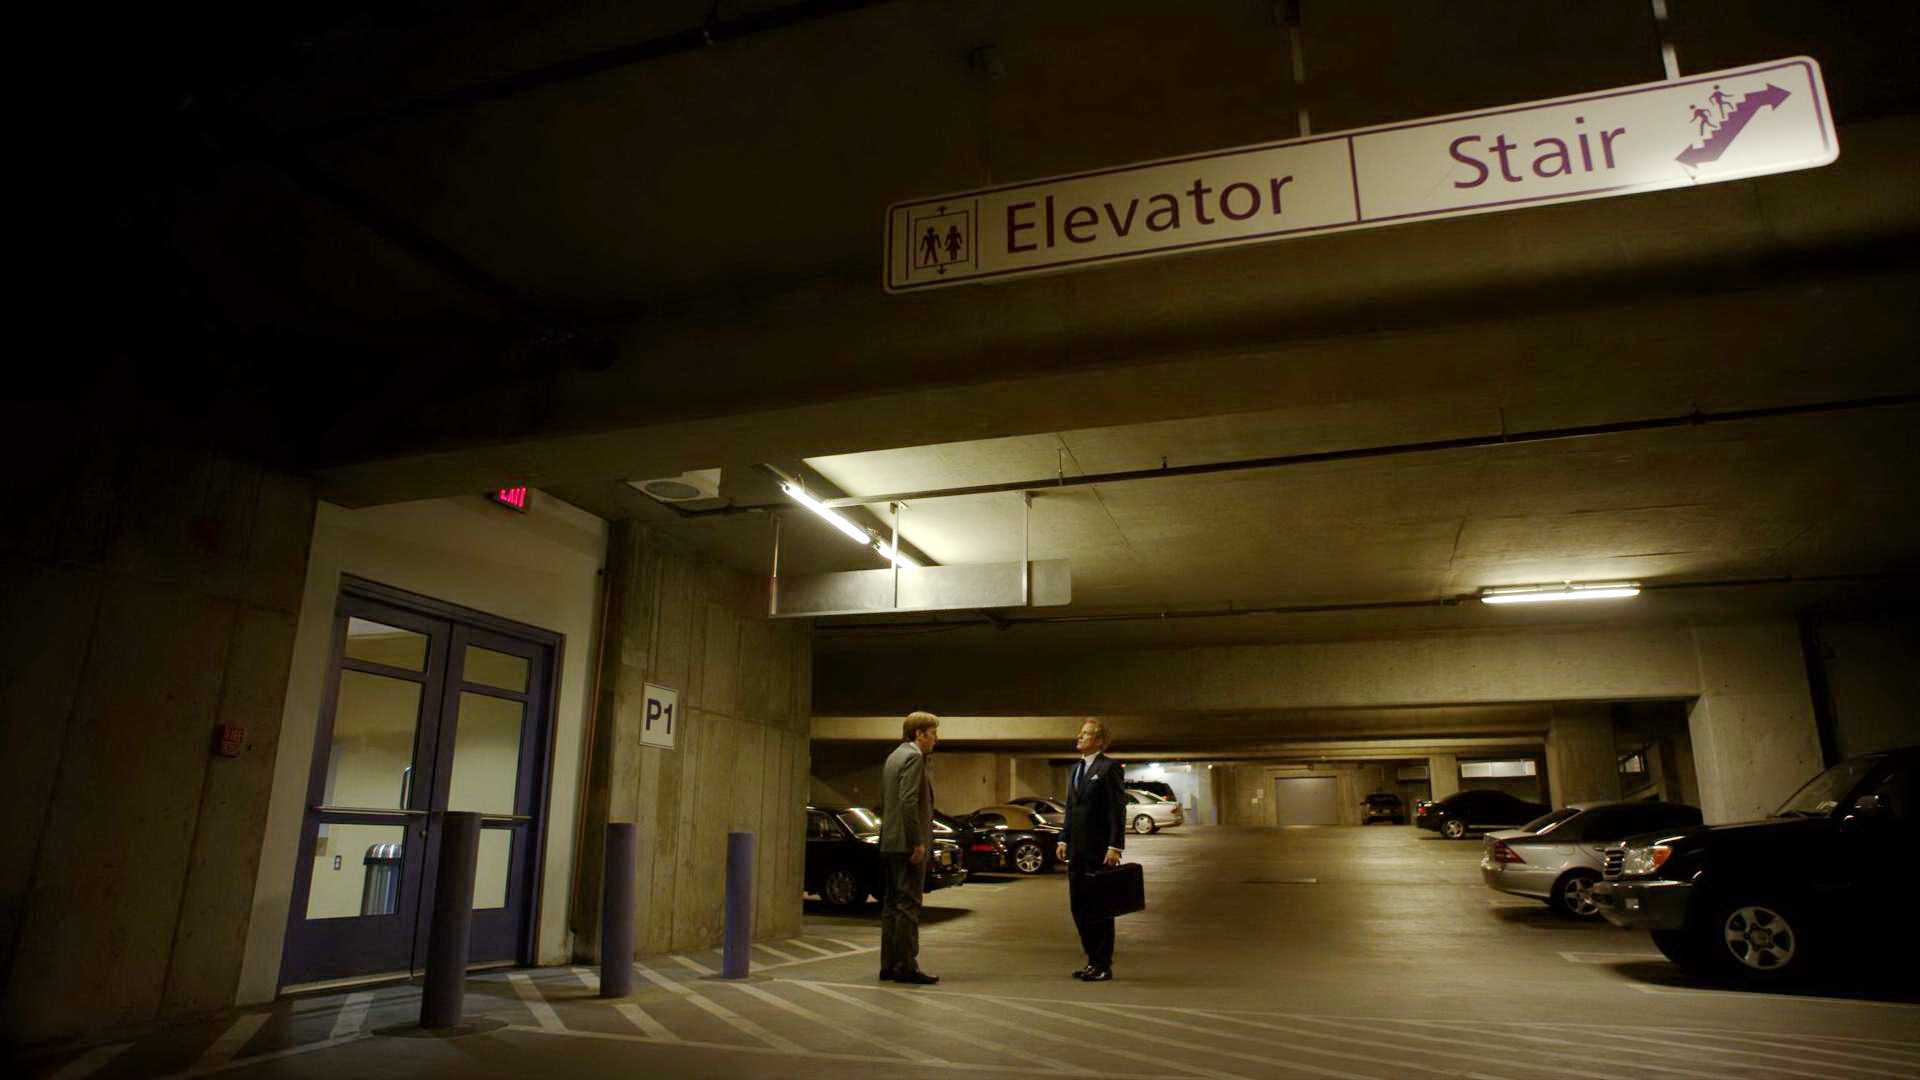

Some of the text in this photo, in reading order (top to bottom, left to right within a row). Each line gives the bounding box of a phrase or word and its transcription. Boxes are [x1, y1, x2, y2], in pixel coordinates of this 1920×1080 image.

[1449, 117, 1625, 189] Stair
[1005, 174, 1294, 254] Elevator
[646, 698, 673, 734] P1
